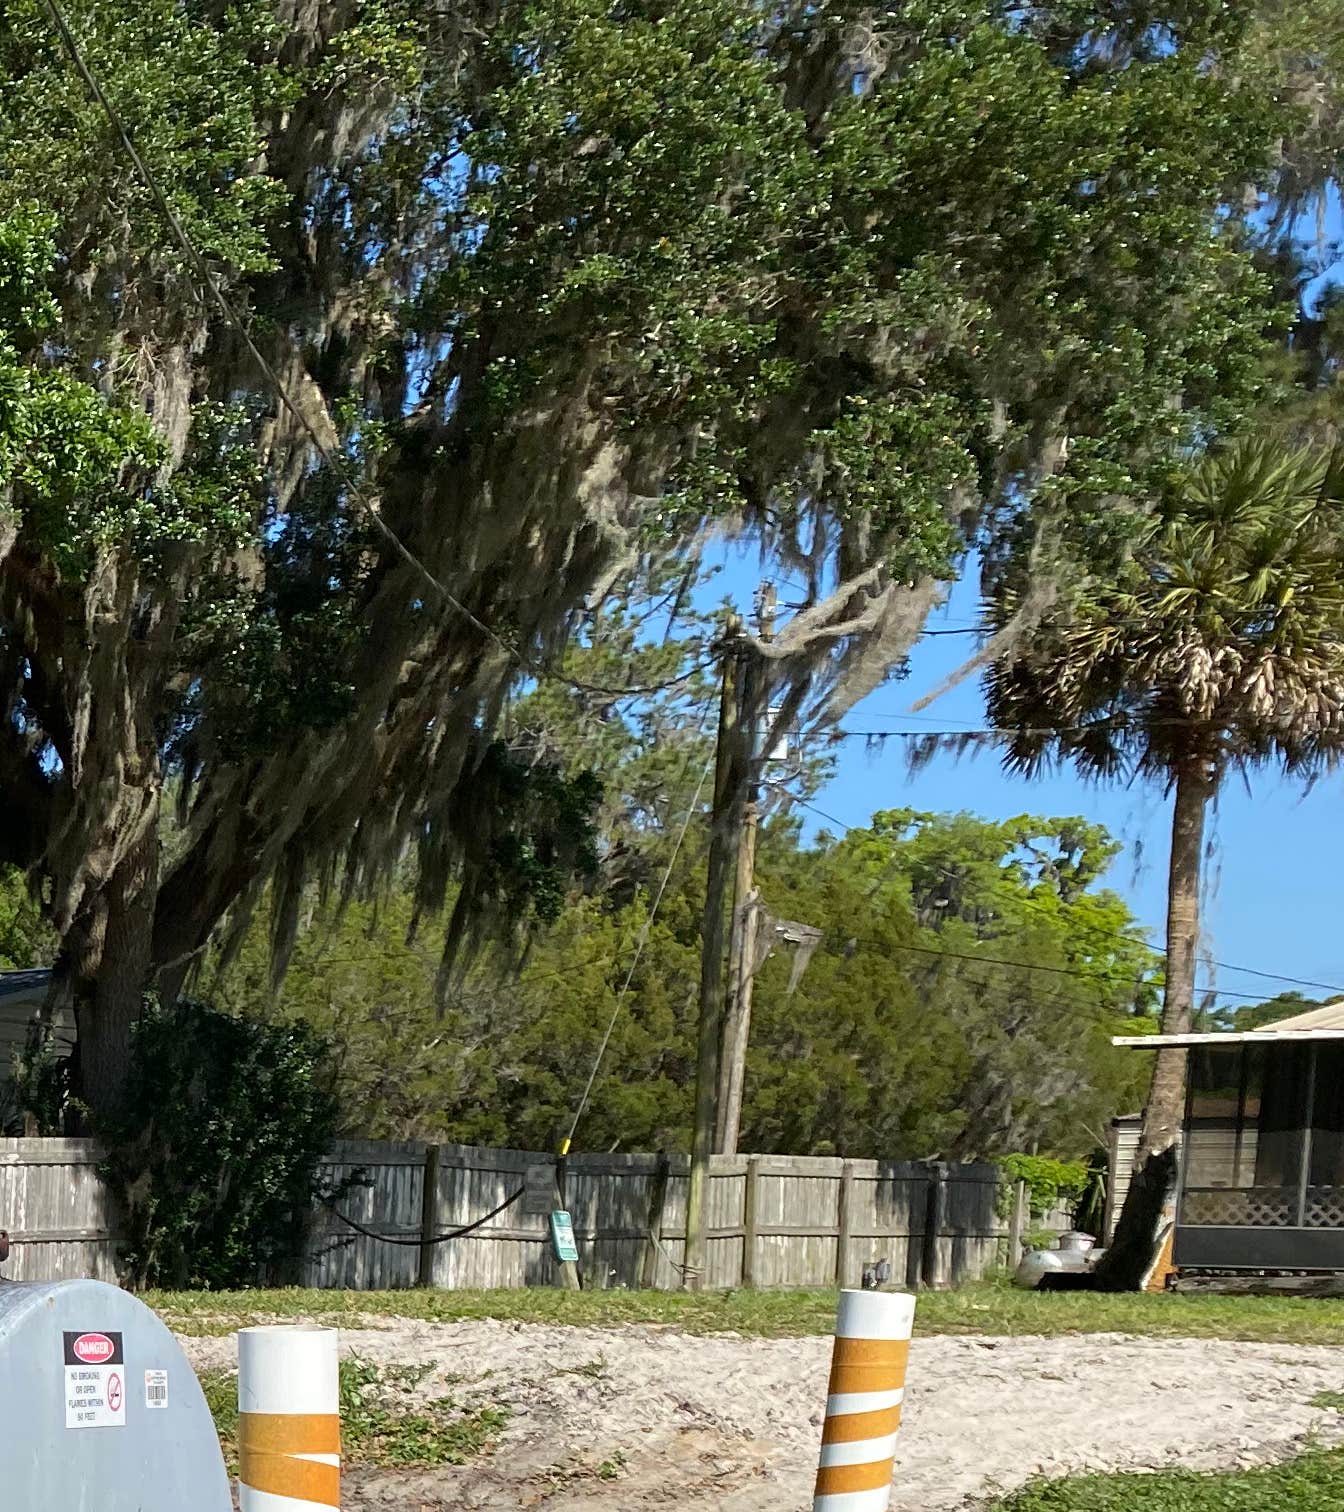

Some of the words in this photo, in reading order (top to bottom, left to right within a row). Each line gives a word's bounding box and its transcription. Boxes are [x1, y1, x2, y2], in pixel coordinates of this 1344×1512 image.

[79, 1341, 109, 1355] DANGER
[76, 1386, 82, 1394] OR
[83, 1386, 96, 1394] OPEN
